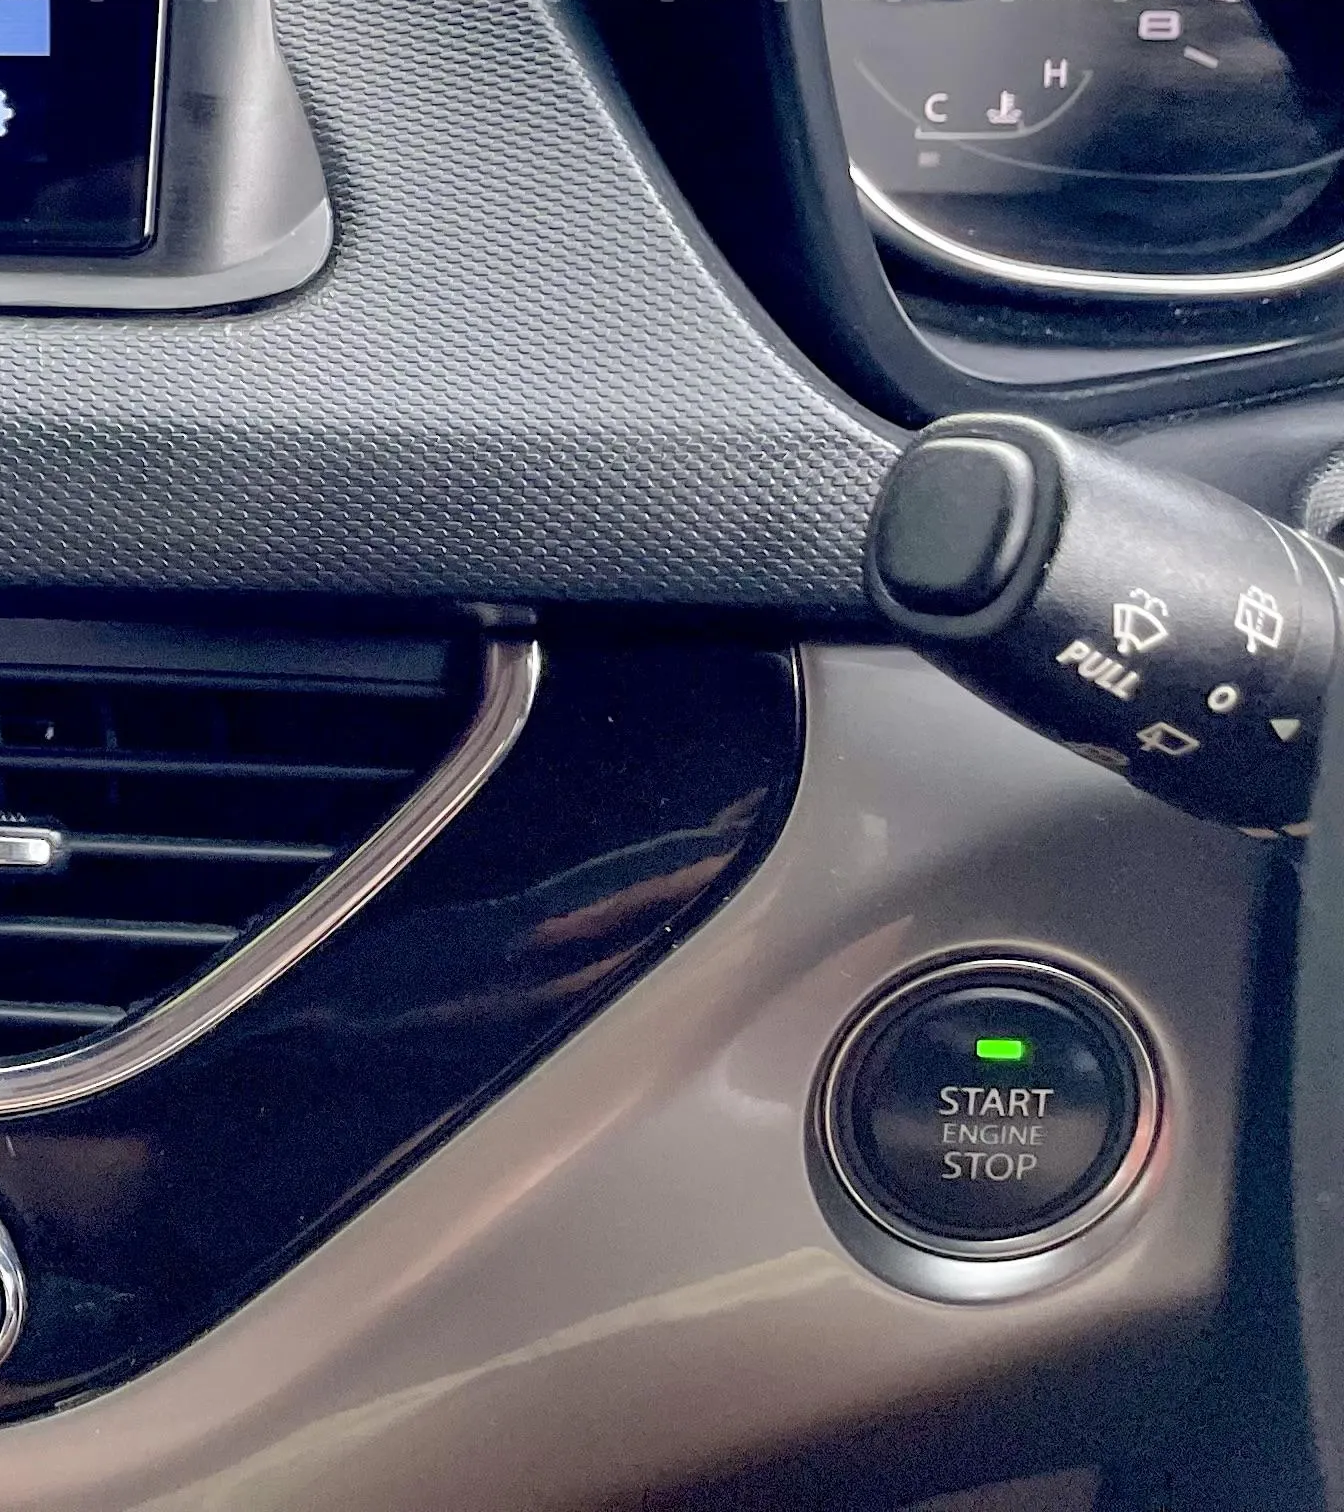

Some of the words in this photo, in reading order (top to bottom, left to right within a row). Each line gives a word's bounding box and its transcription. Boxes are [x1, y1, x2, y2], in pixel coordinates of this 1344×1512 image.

[1138, 9, 1182, 41] 8
[1044, 58, 1068, 89] H
[924, 92, 949, 123] C
[1056, 639, 1144, 701] PULL
[938, 1086, 1054, 1118] START
[942, 1122, 1044, 1146] ENGINE
[941, 1151, 1038, 1182] STOP
